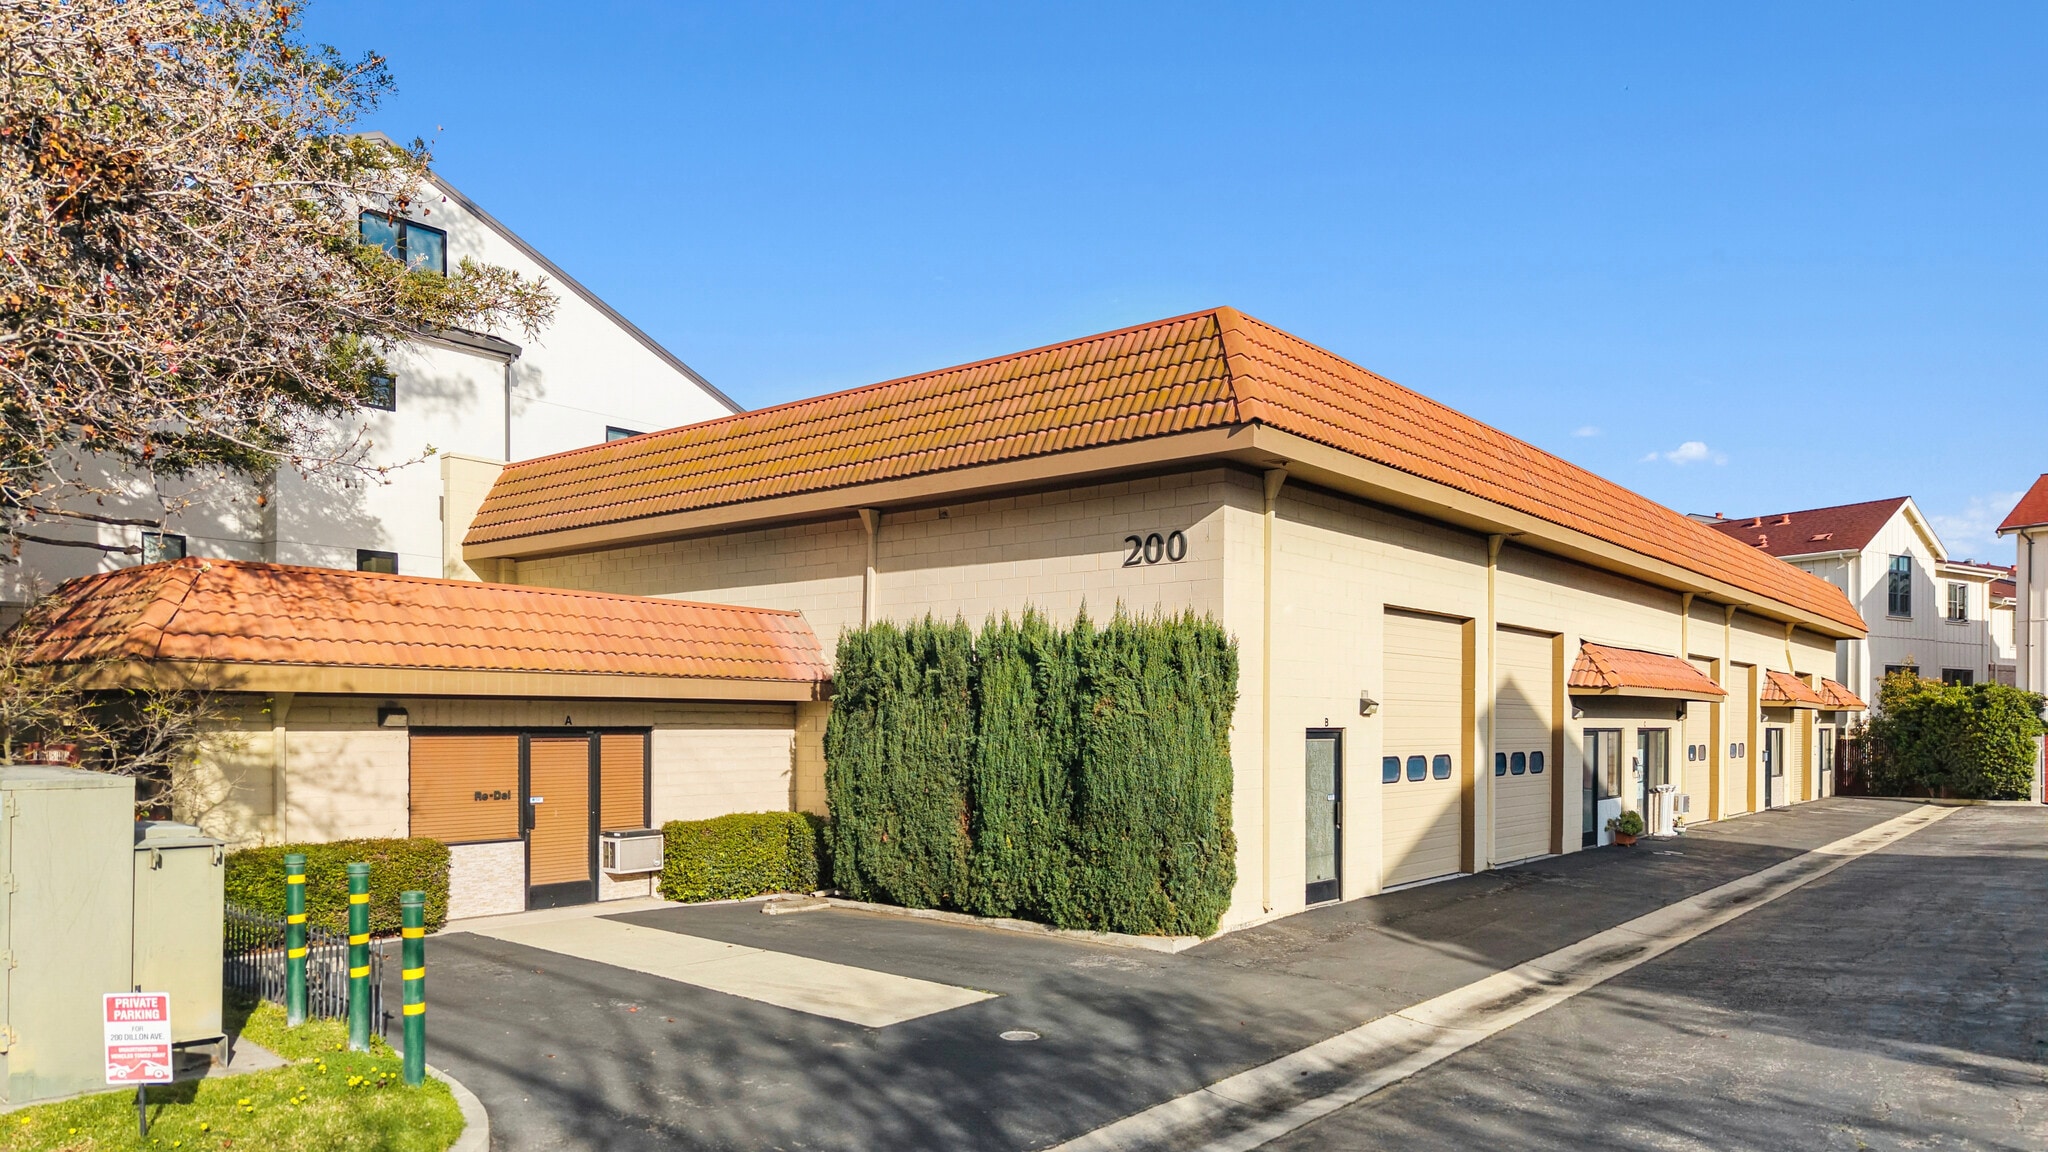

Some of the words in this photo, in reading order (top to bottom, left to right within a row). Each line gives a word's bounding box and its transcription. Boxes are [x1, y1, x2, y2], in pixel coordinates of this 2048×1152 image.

[1123, 530, 1188, 567] 200
[565, 715, 573, 725] A
[115, 997, 158, 1009] PRIVATE
[113, 1009, 160, 1020] PARKING
[124, 1033, 149, 1041] DILLON
